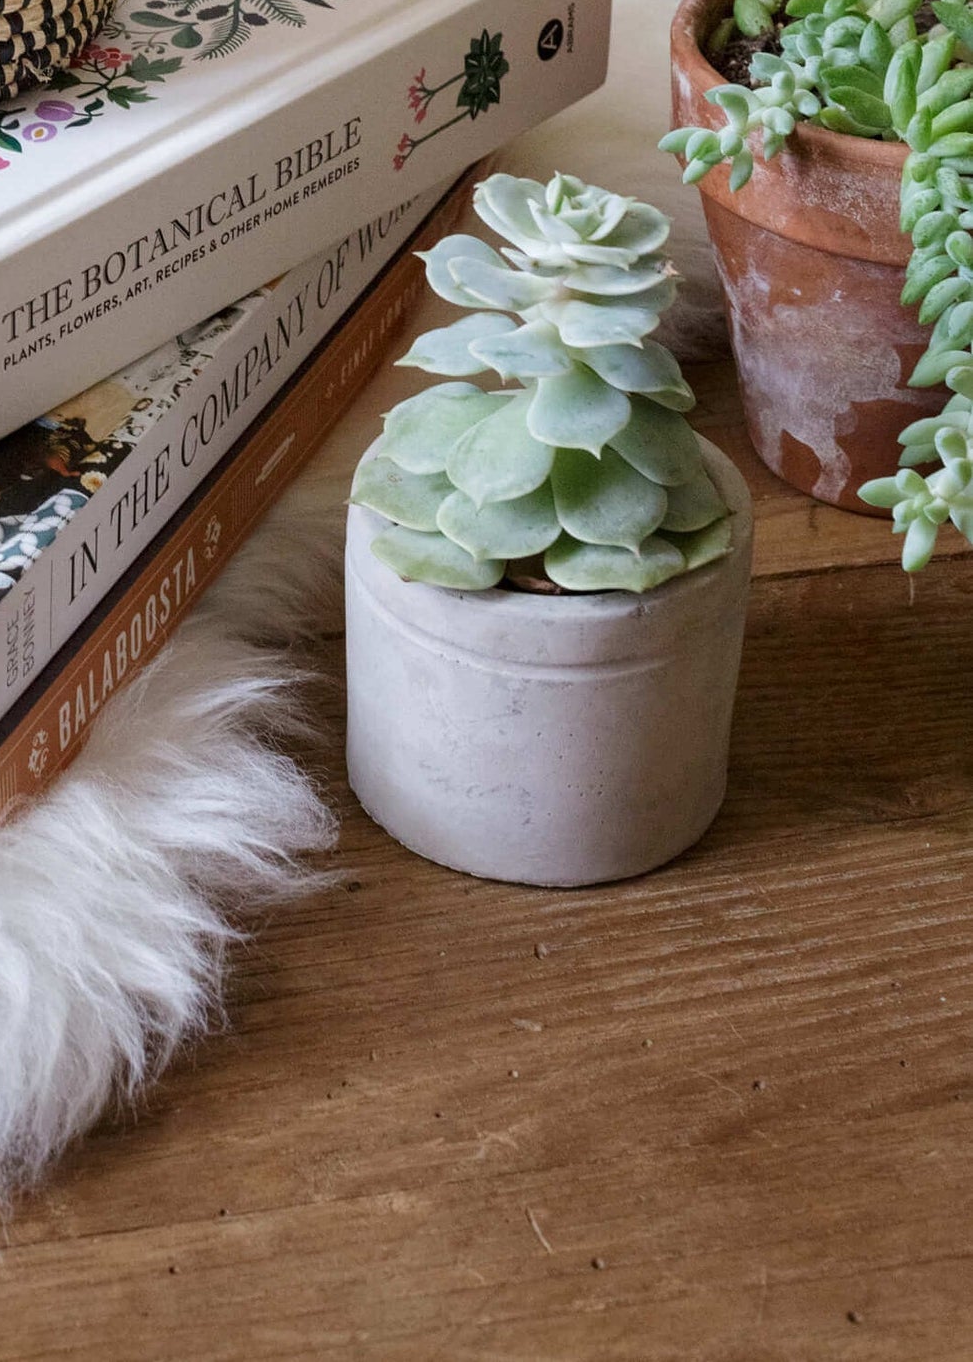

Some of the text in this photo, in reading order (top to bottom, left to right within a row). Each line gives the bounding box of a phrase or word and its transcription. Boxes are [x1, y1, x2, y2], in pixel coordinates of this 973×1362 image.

[1, 115, 363, 344] THE BOTANICAL BIBLE
[2, 156, 361, 371] PLANTS, FLOWERS, ART, RECIPES & OTHER HOME REMEDIES
[67, 522, 101, 607] IN
[109, 443, 171, 551] THE
[180, 281, 311, 469] COMPANY
[316, 238, 350, 310] OF
[6, 609, 20, 688] GRACE
[22, 586, 36, 678] BONNEY
[58, 545, 197, 753] BALABOOSTA
